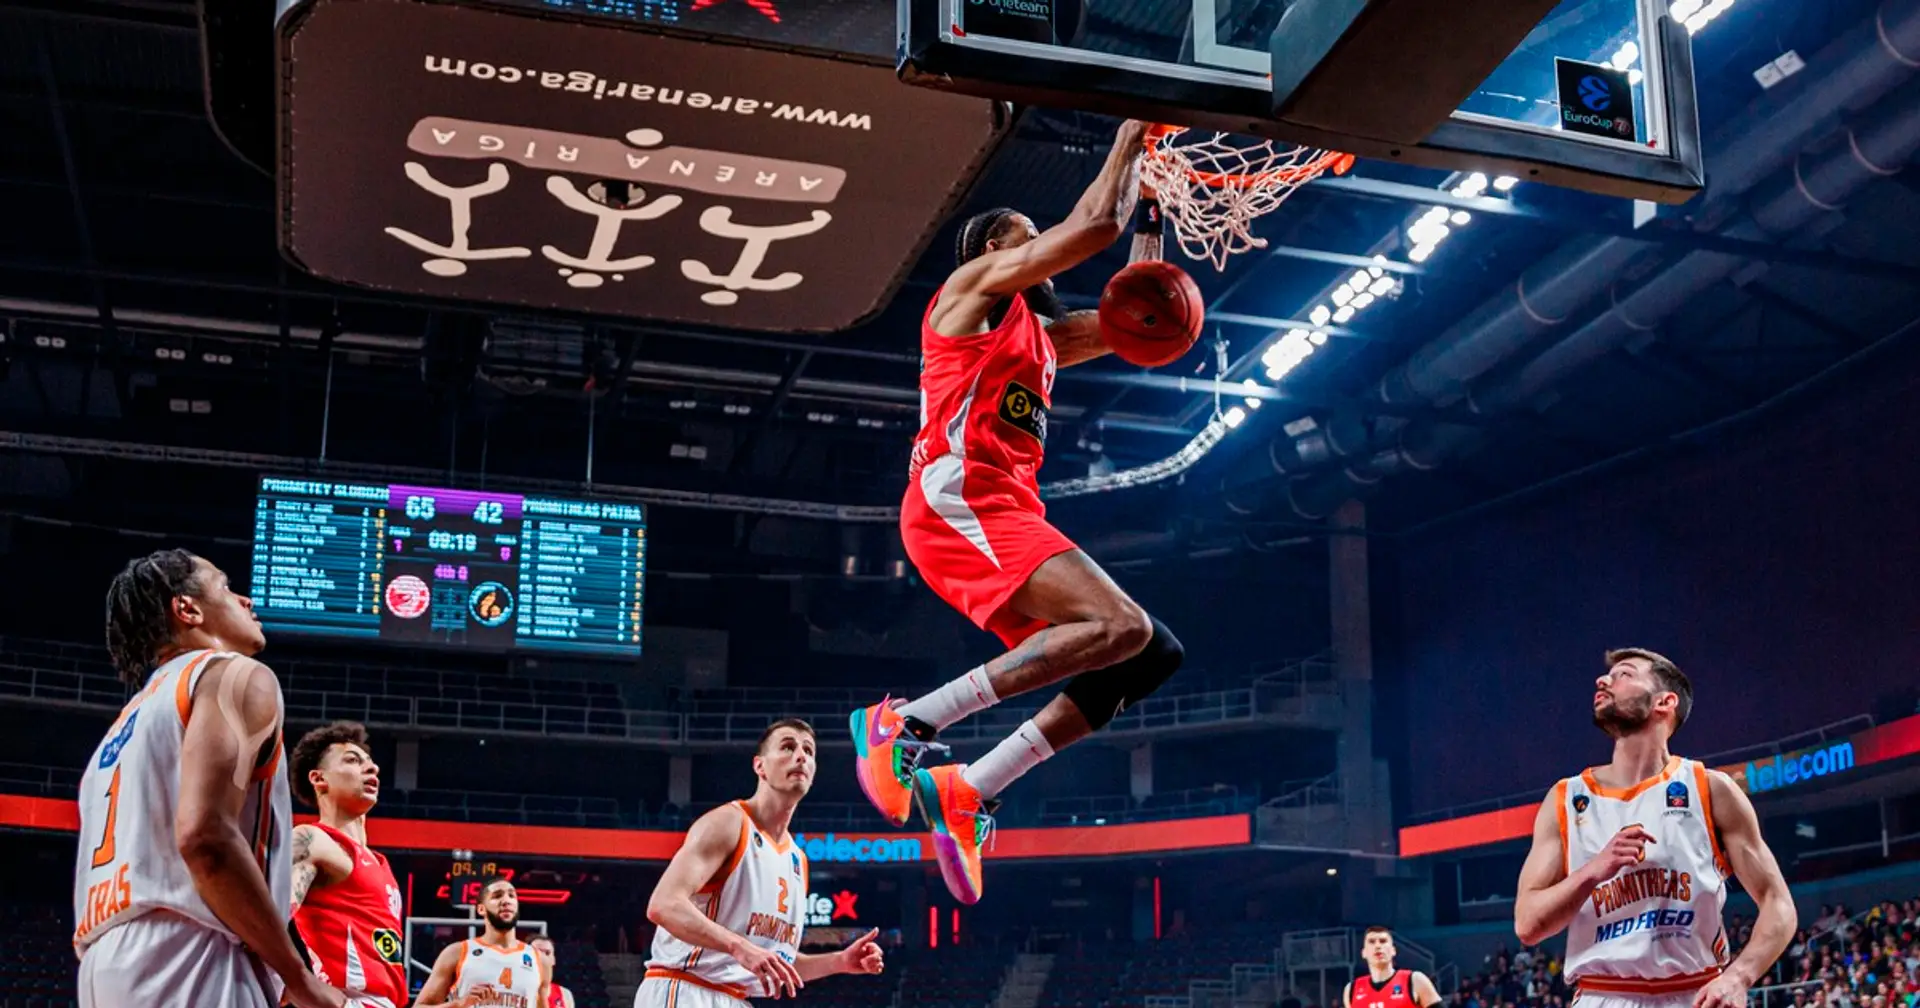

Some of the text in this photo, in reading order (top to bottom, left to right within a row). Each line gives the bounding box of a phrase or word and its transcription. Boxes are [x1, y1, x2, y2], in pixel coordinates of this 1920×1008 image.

[424, 55, 871, 130] www.arenariga.com
[1564, 110, 1613, 130] EuroCup
[406, 496, 435, 520] 65
[473, 501, 503, 524] 42
[1745, 742, 1854, 794] telecom
[92, 763, 121, 869] 1
[795, 832, 921, 862] telecom
[777, 877, 788, 914] 2
[1591, 867, 1691, 918] PROMITHEAS
[498, 967, 513, 990] 4
